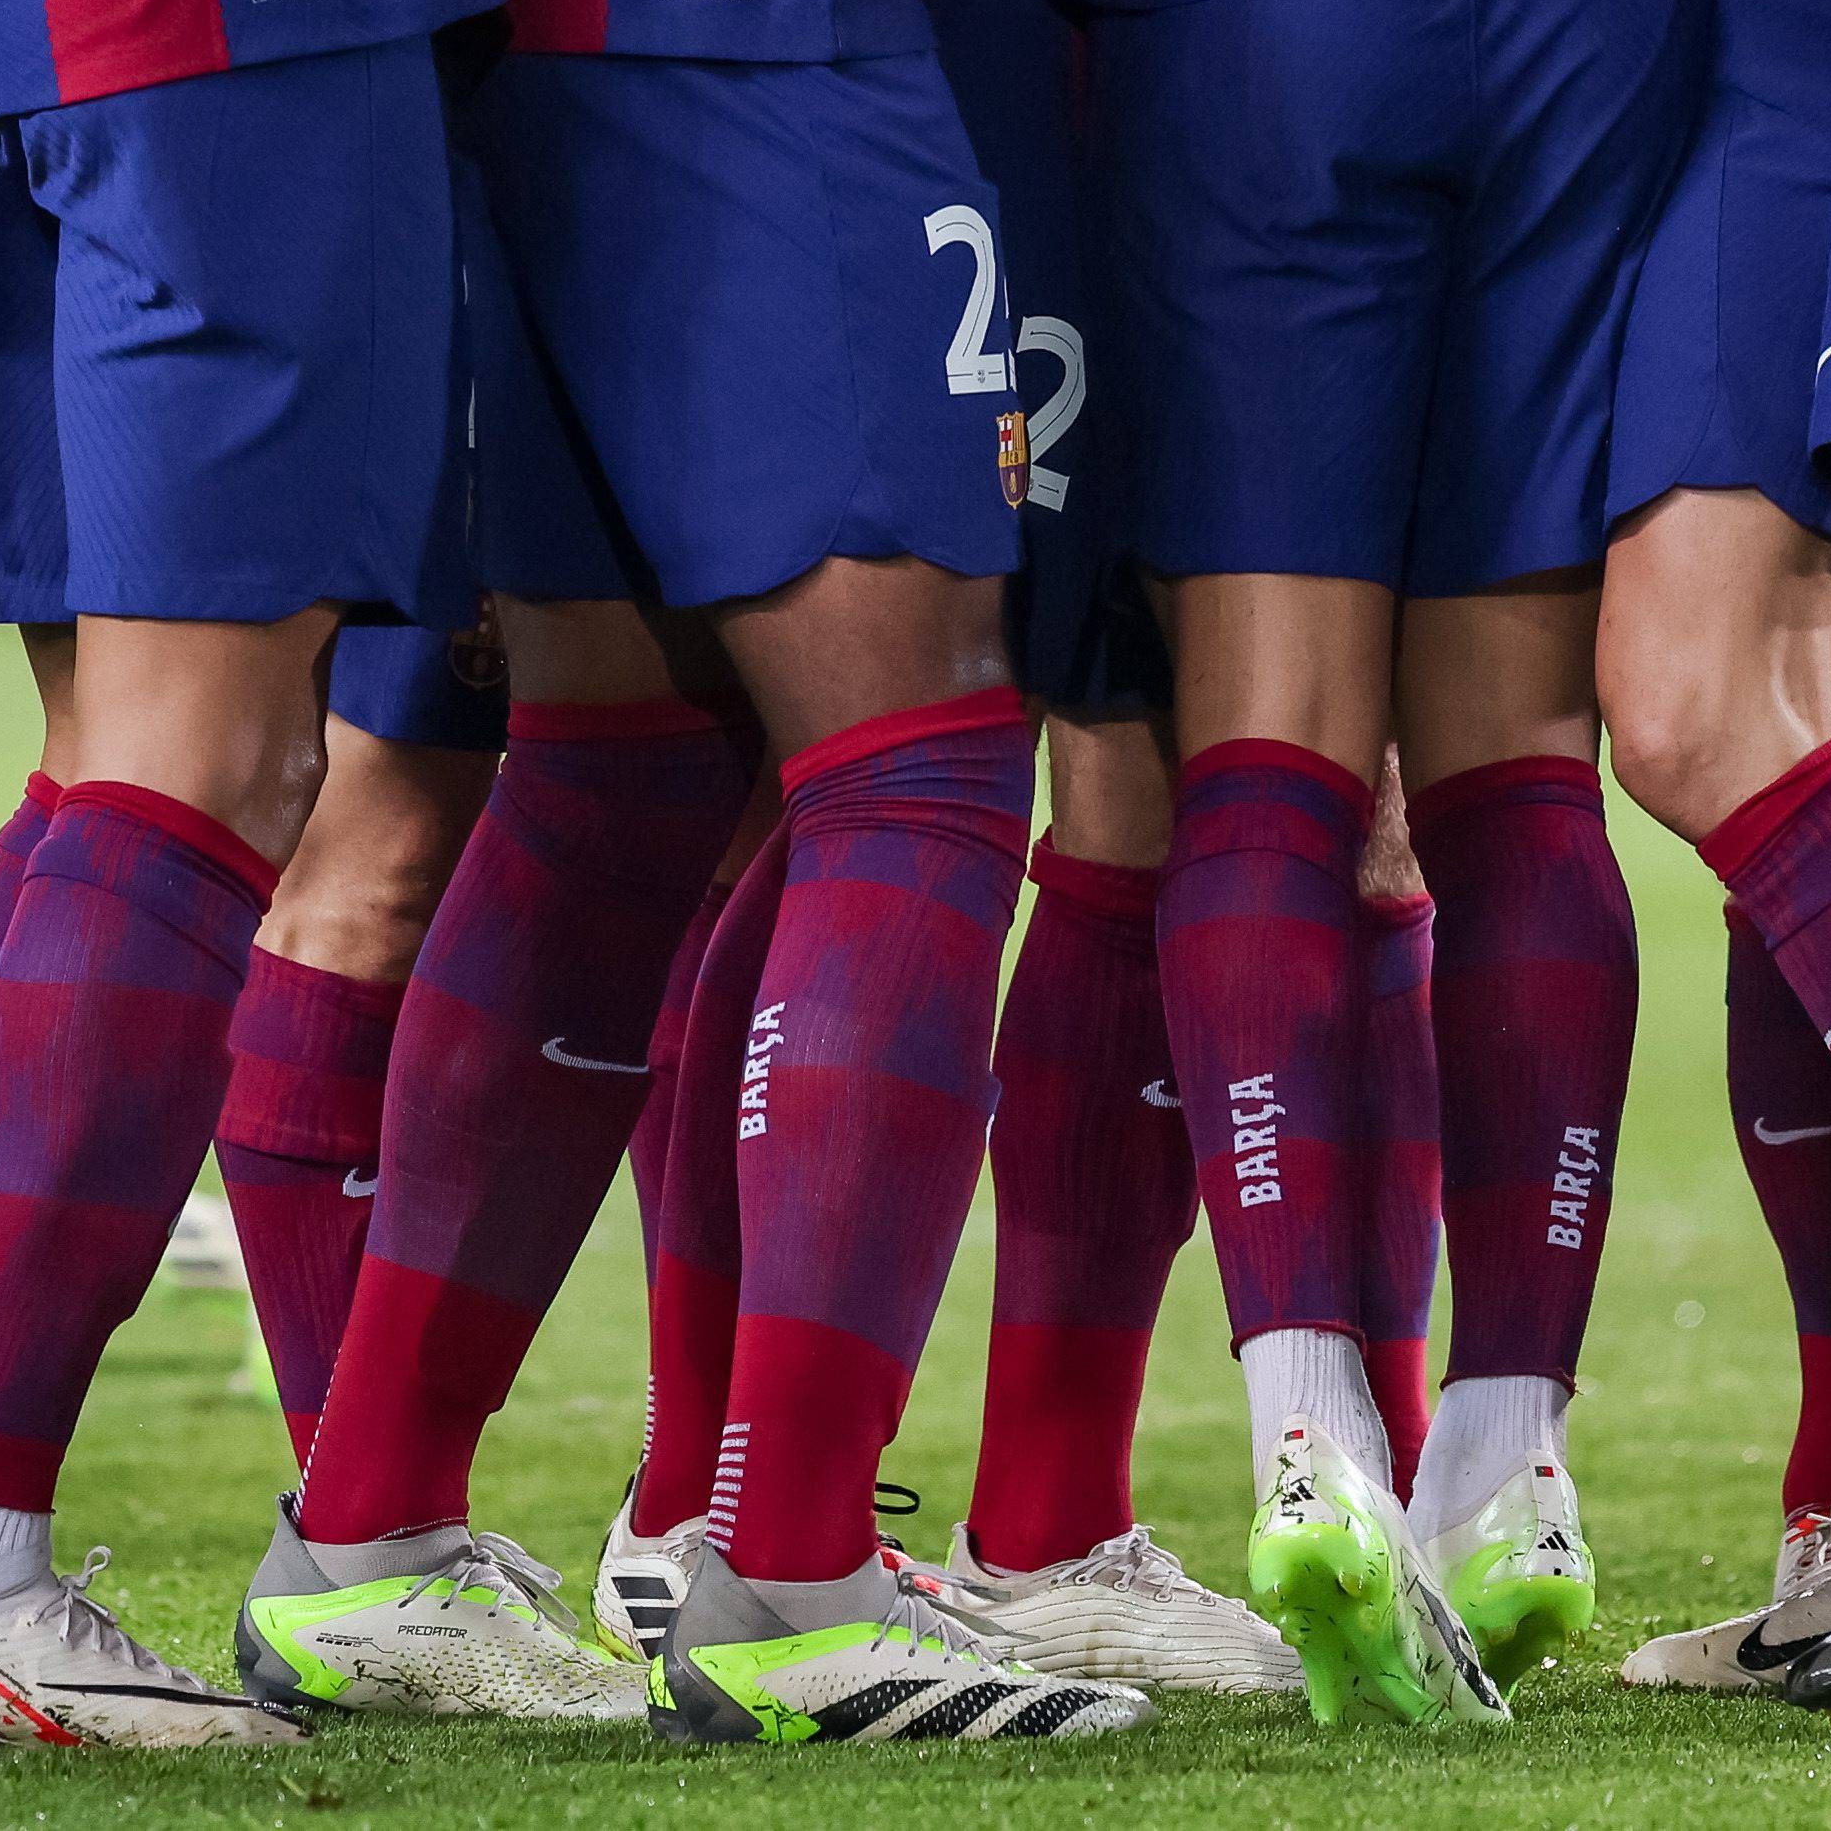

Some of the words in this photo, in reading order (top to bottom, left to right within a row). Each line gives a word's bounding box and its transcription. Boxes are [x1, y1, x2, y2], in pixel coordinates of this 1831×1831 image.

[923, 204, 1017, 395] 2
[739, 1001, 786, 1141] BARÇA
[1228, 1073, 1286, 1208] BARÇA
[1547, 1126, 1600, 1250] BARÇA
[397, 1624, 468, 1639] PREDATOR
